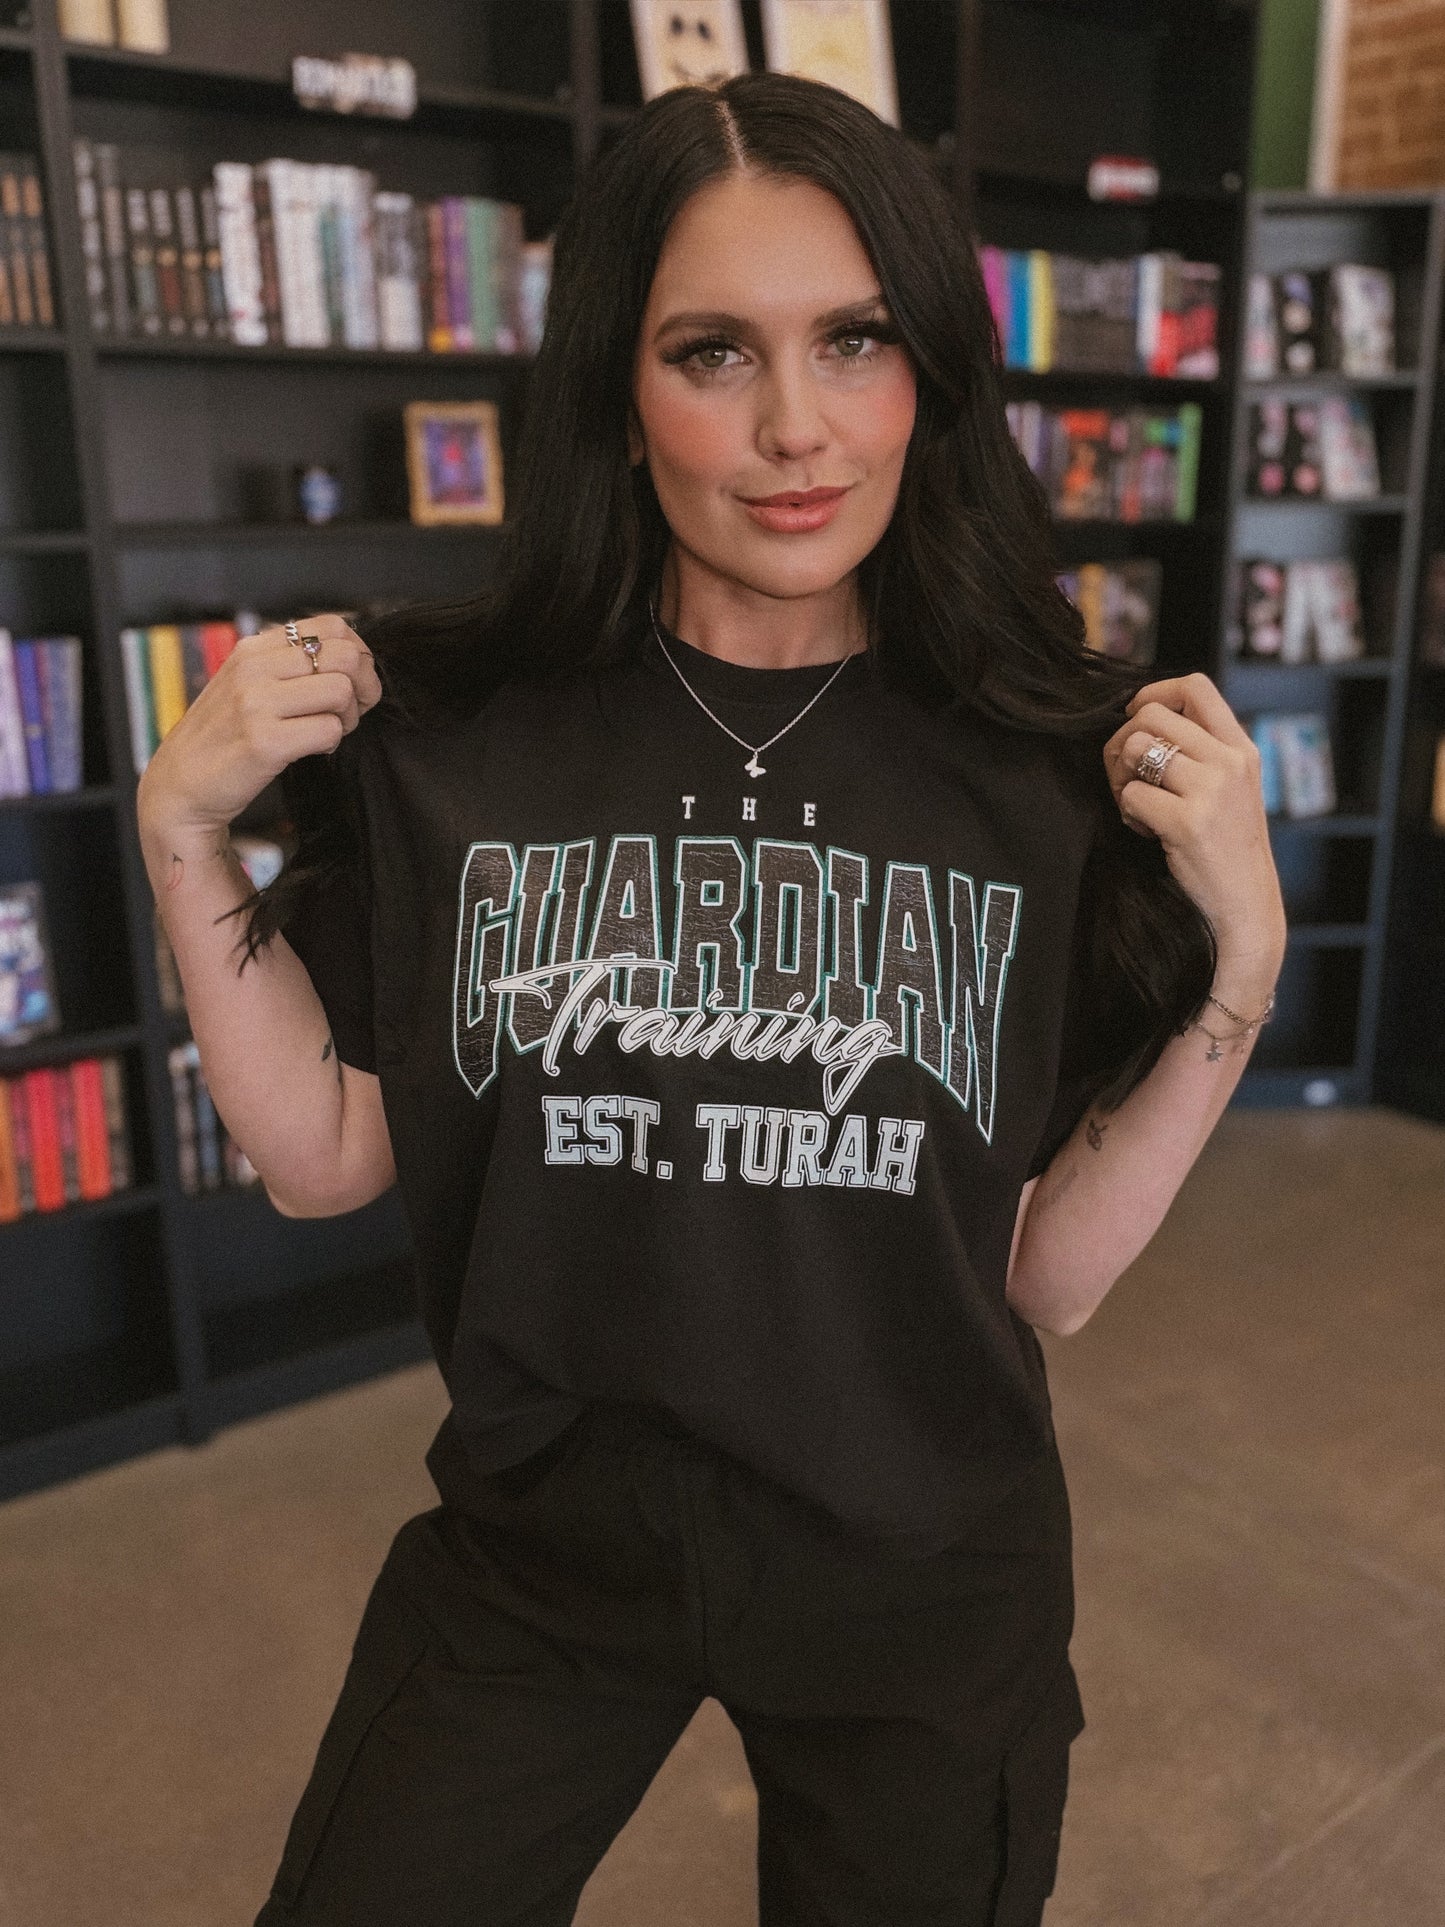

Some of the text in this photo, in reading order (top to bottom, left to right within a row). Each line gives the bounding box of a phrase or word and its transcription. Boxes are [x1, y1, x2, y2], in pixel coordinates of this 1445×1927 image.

[682, 796, 816, 826] THE
[452, 834, 1022, 1146] GUARDIAN
[489, 958, 903, 1116] Training
[542, 1095, 925, 1195] EST. TURAH
